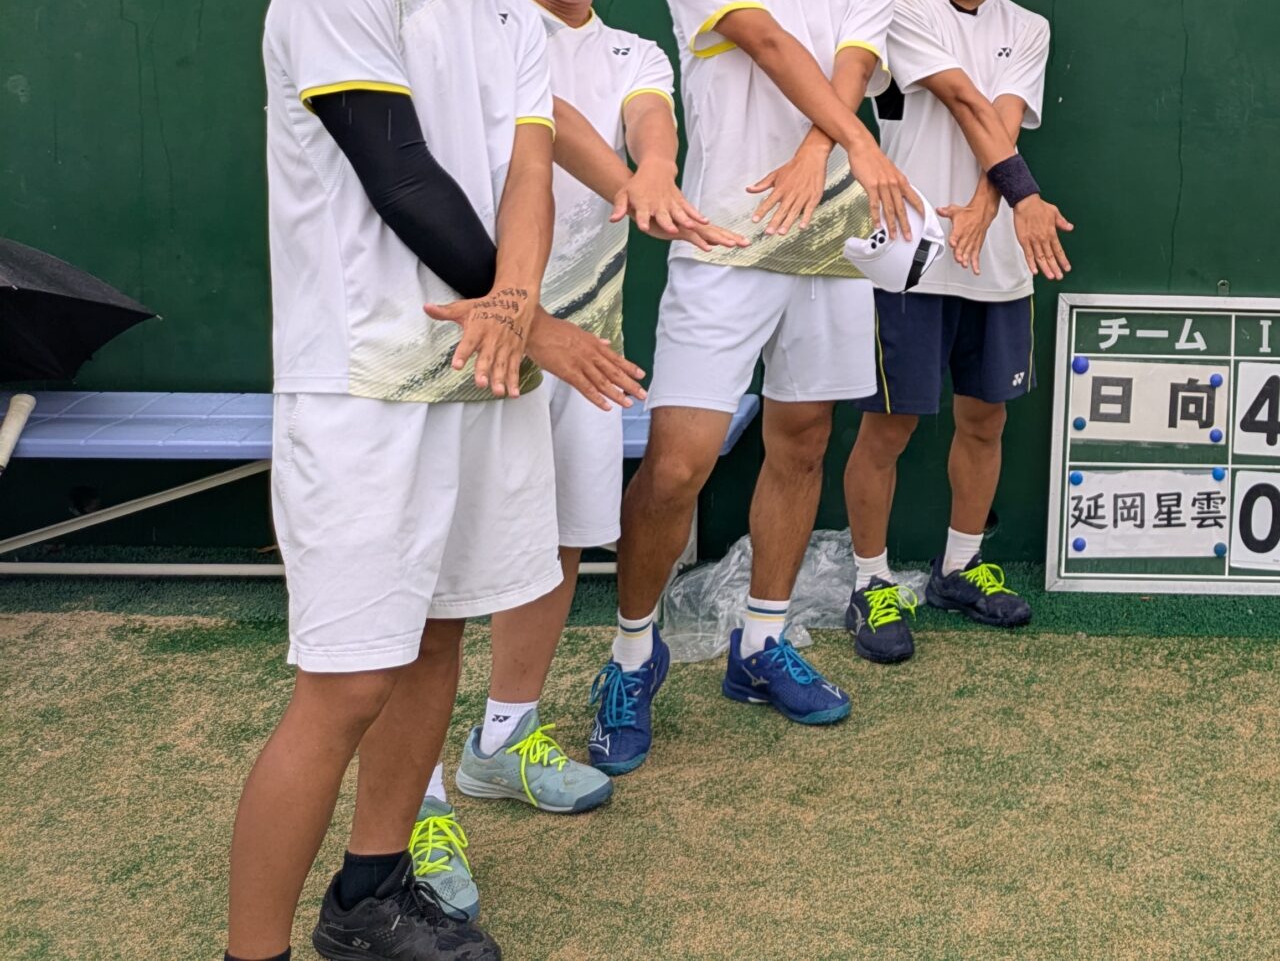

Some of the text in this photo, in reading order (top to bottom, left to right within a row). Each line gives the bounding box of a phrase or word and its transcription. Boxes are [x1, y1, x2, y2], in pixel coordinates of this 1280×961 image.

[1098, 317, 1208, 352] チーム
[1089, 377, 1217, 429] 日向
[1070, 491, 1228, 531] 延岡星雲
